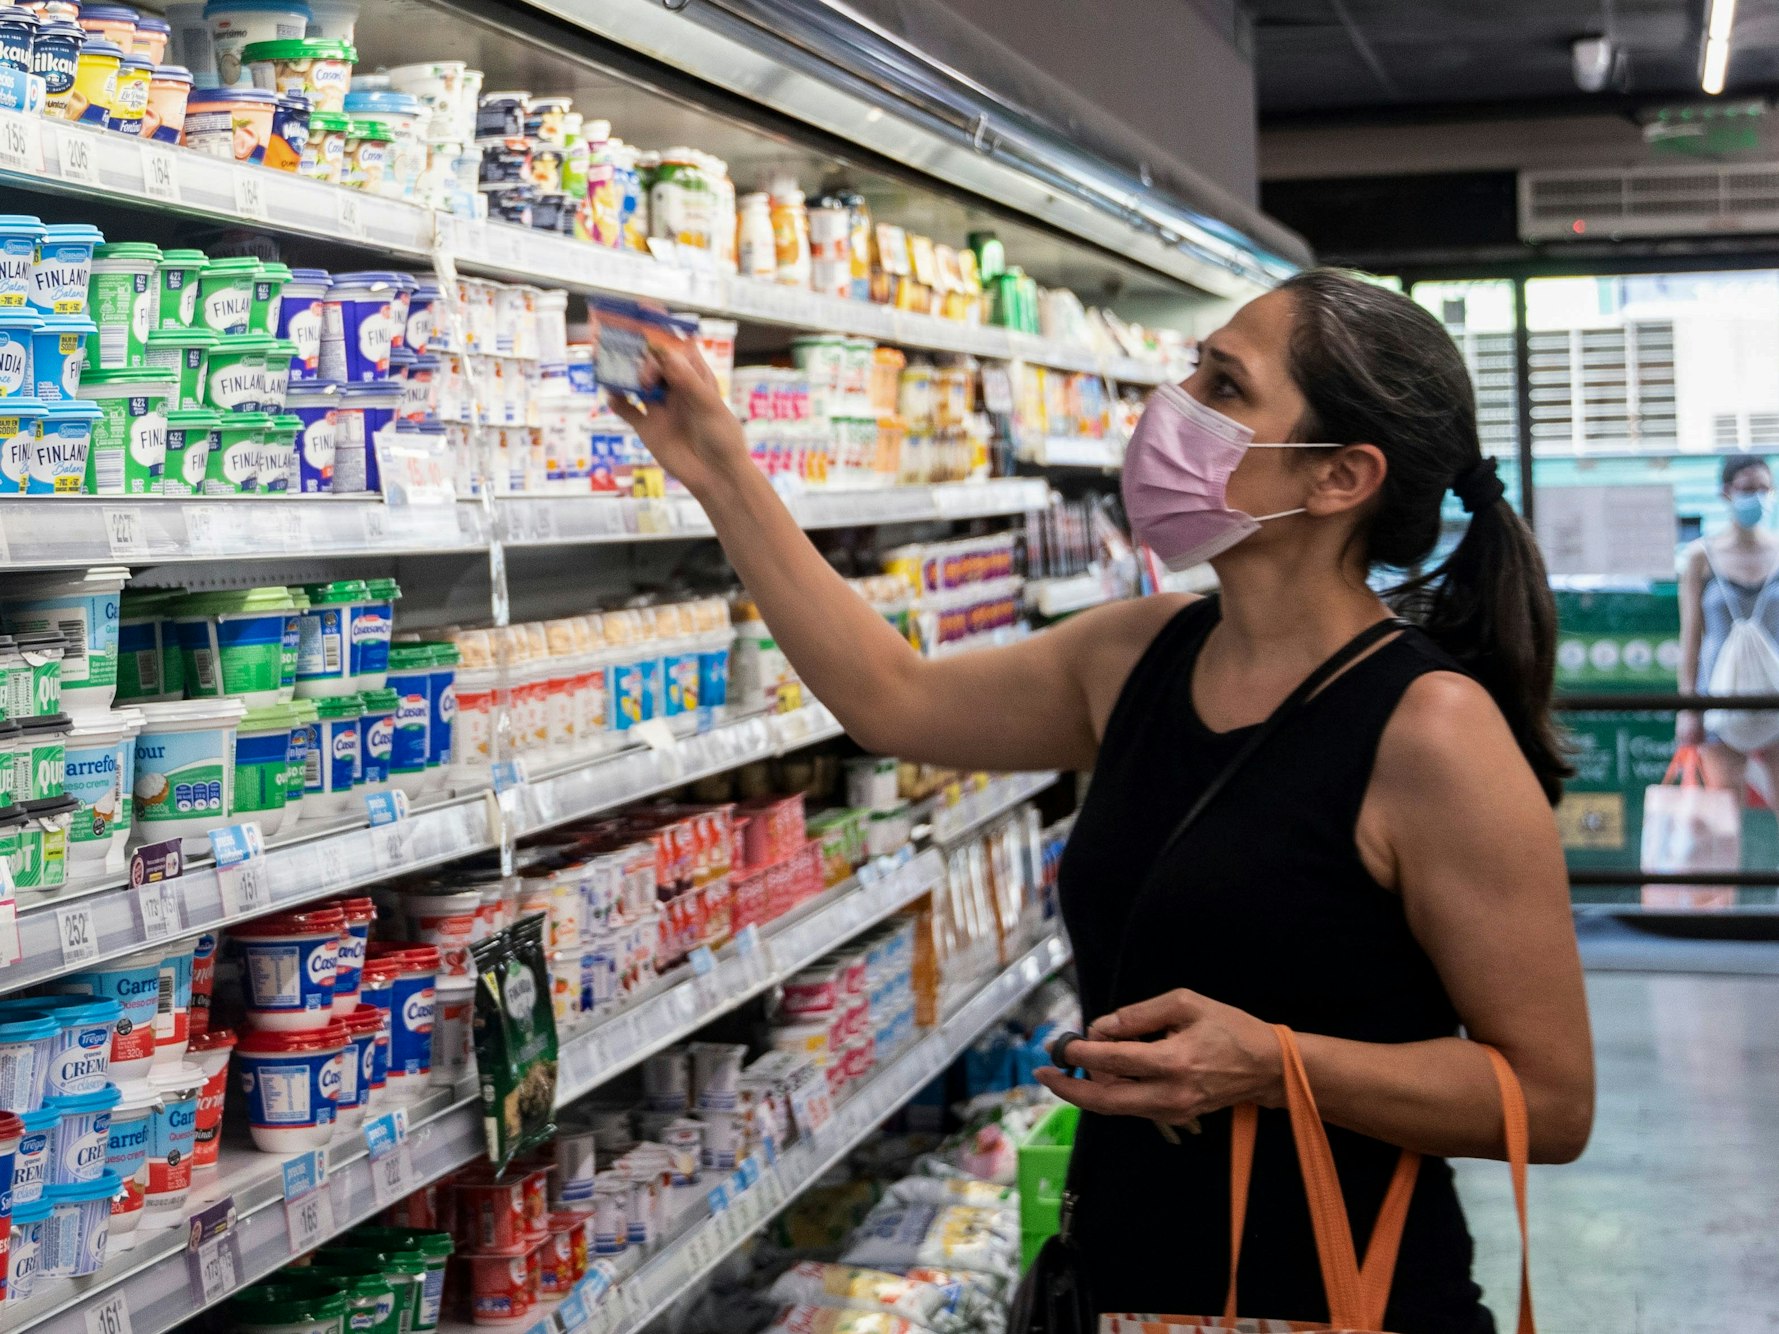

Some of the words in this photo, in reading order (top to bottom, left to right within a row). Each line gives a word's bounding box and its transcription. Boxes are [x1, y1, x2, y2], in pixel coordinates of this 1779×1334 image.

[68, 139, 88, 170] 206
[152, 157, 170, 185] 164
[65, 913, 88, 946] 252
